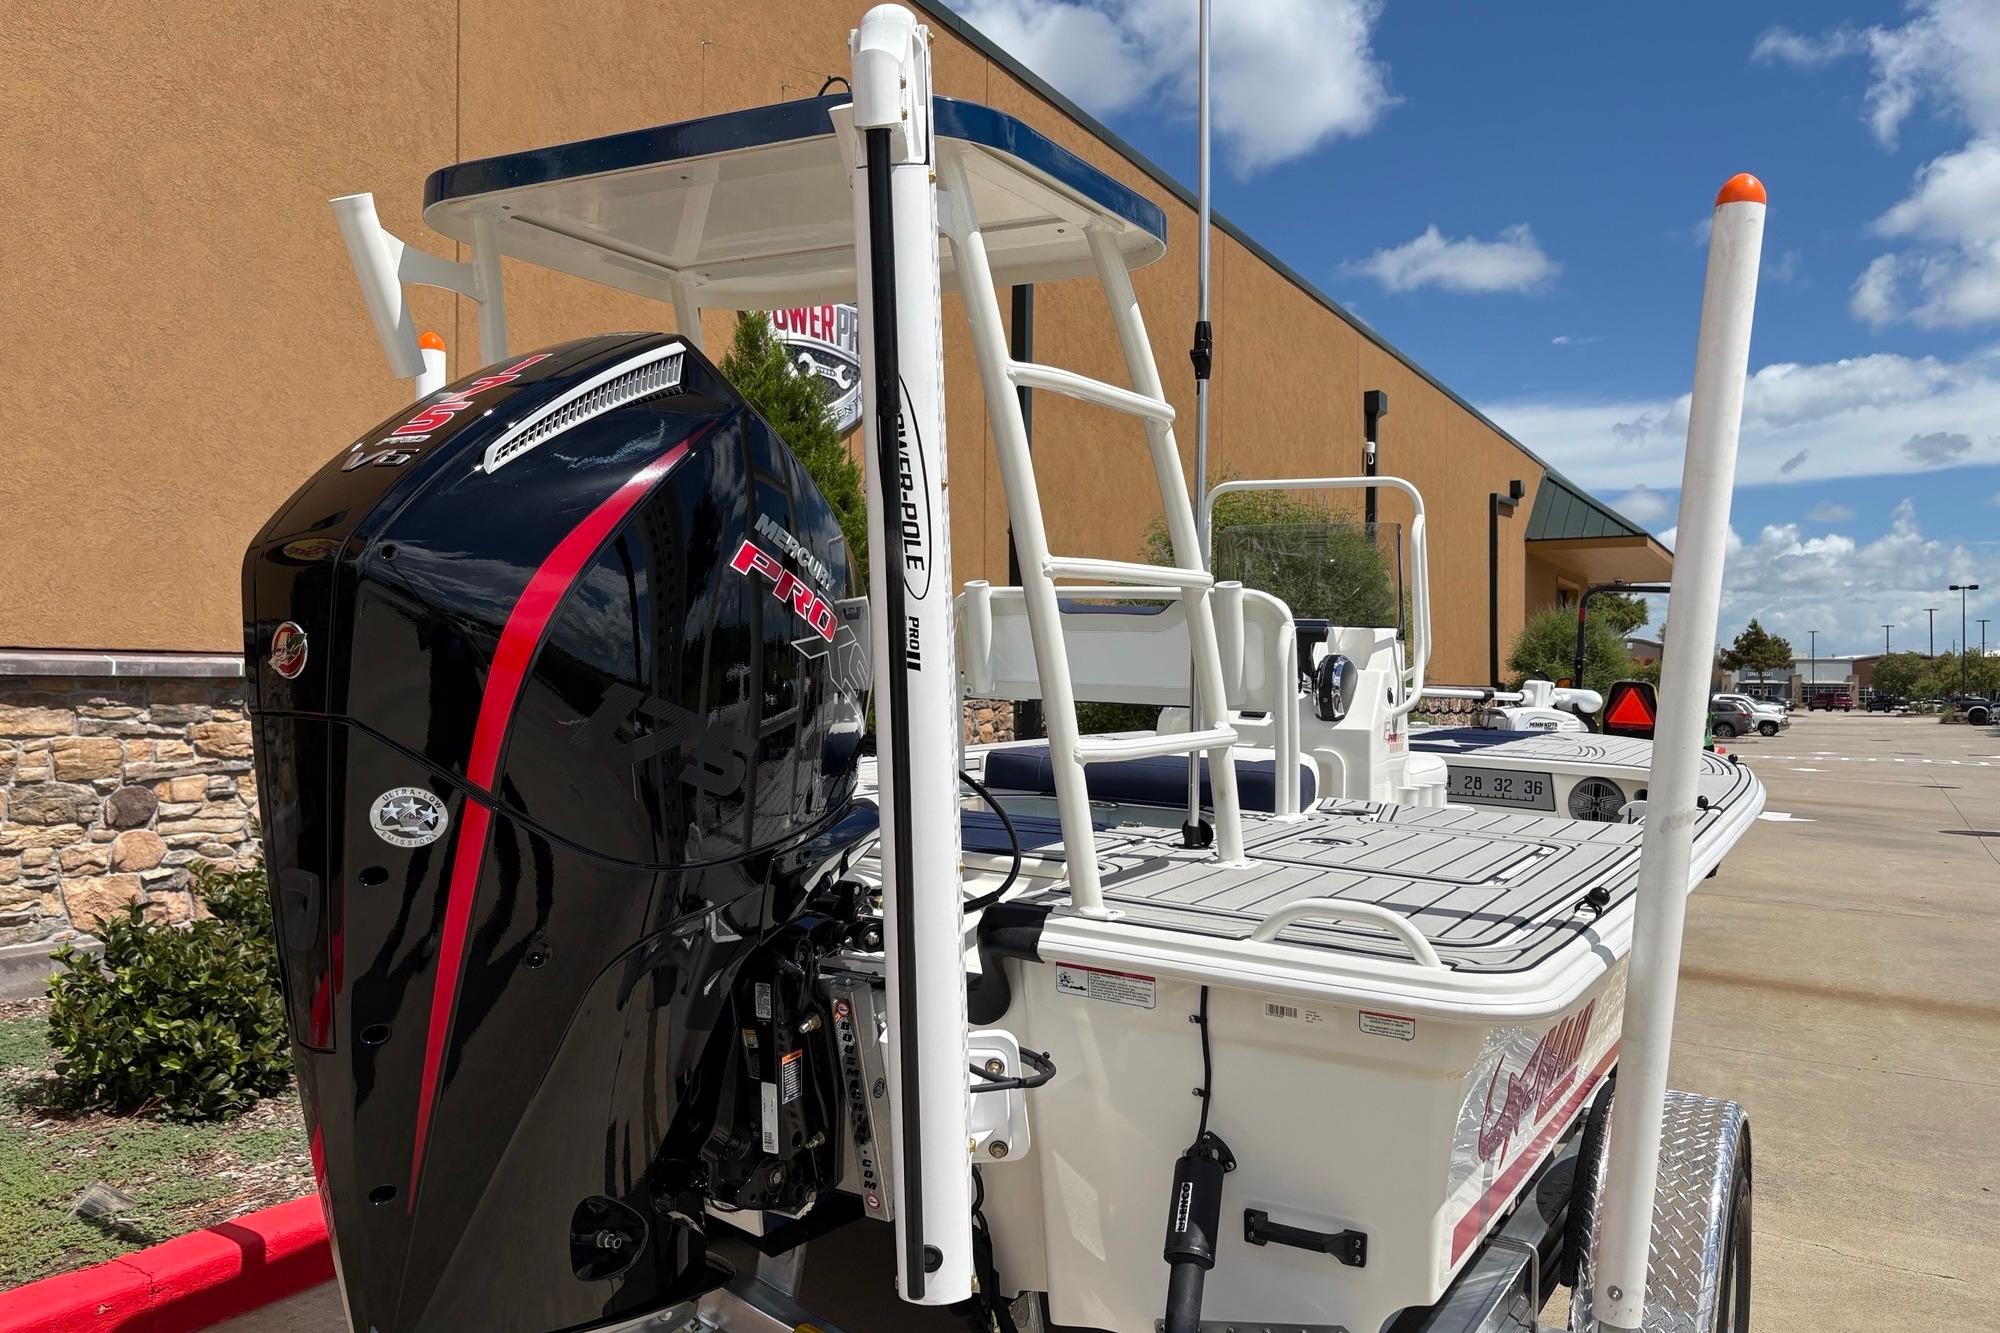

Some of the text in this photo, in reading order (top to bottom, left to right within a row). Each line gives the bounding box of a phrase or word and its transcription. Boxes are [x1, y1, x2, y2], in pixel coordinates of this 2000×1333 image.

[341, 448, 420, 473] V6
[754, 512, 836, 592] MERCURY
[730, 539, 839, 643] PRO
[908, 615, 920, 650] PRO
[382, 788, 443, 809] ULTRA LOW
[1464, 775, 1482, 790] 28
[1494, 777, 1512, 793] 32
[1523, 780, 1543, 795] 36
